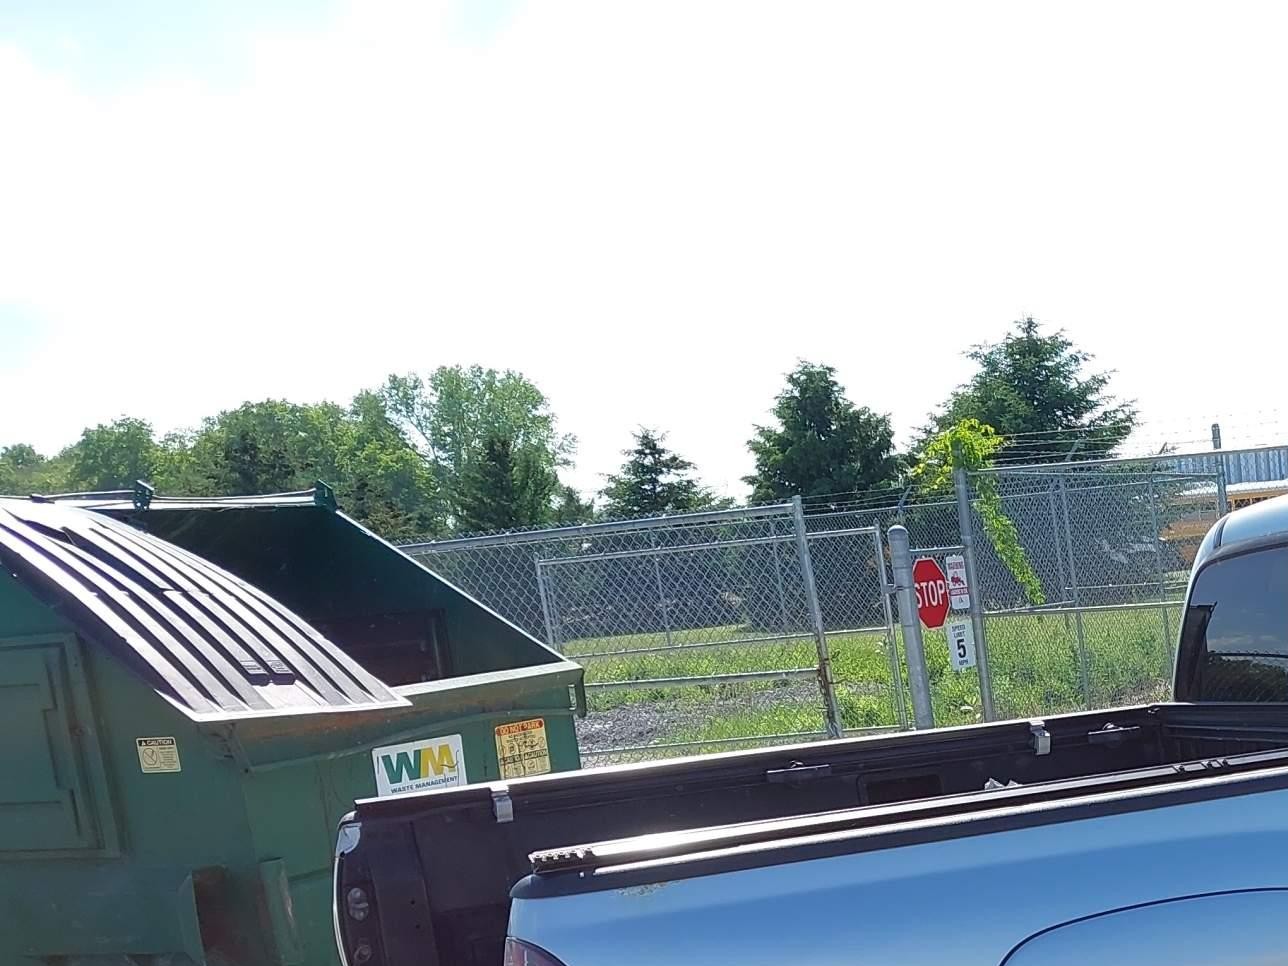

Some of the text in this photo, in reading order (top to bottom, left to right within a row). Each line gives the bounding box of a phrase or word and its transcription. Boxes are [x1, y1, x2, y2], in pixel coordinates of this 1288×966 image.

[914, 580, 945, 608] STOP
[951, 624, 966, 632] SPEED
[957, 638, 967, 658] 5
[381, 744, 457, 785] WM
[391, 775, 458, 794] WASTE MANAGEMENT
